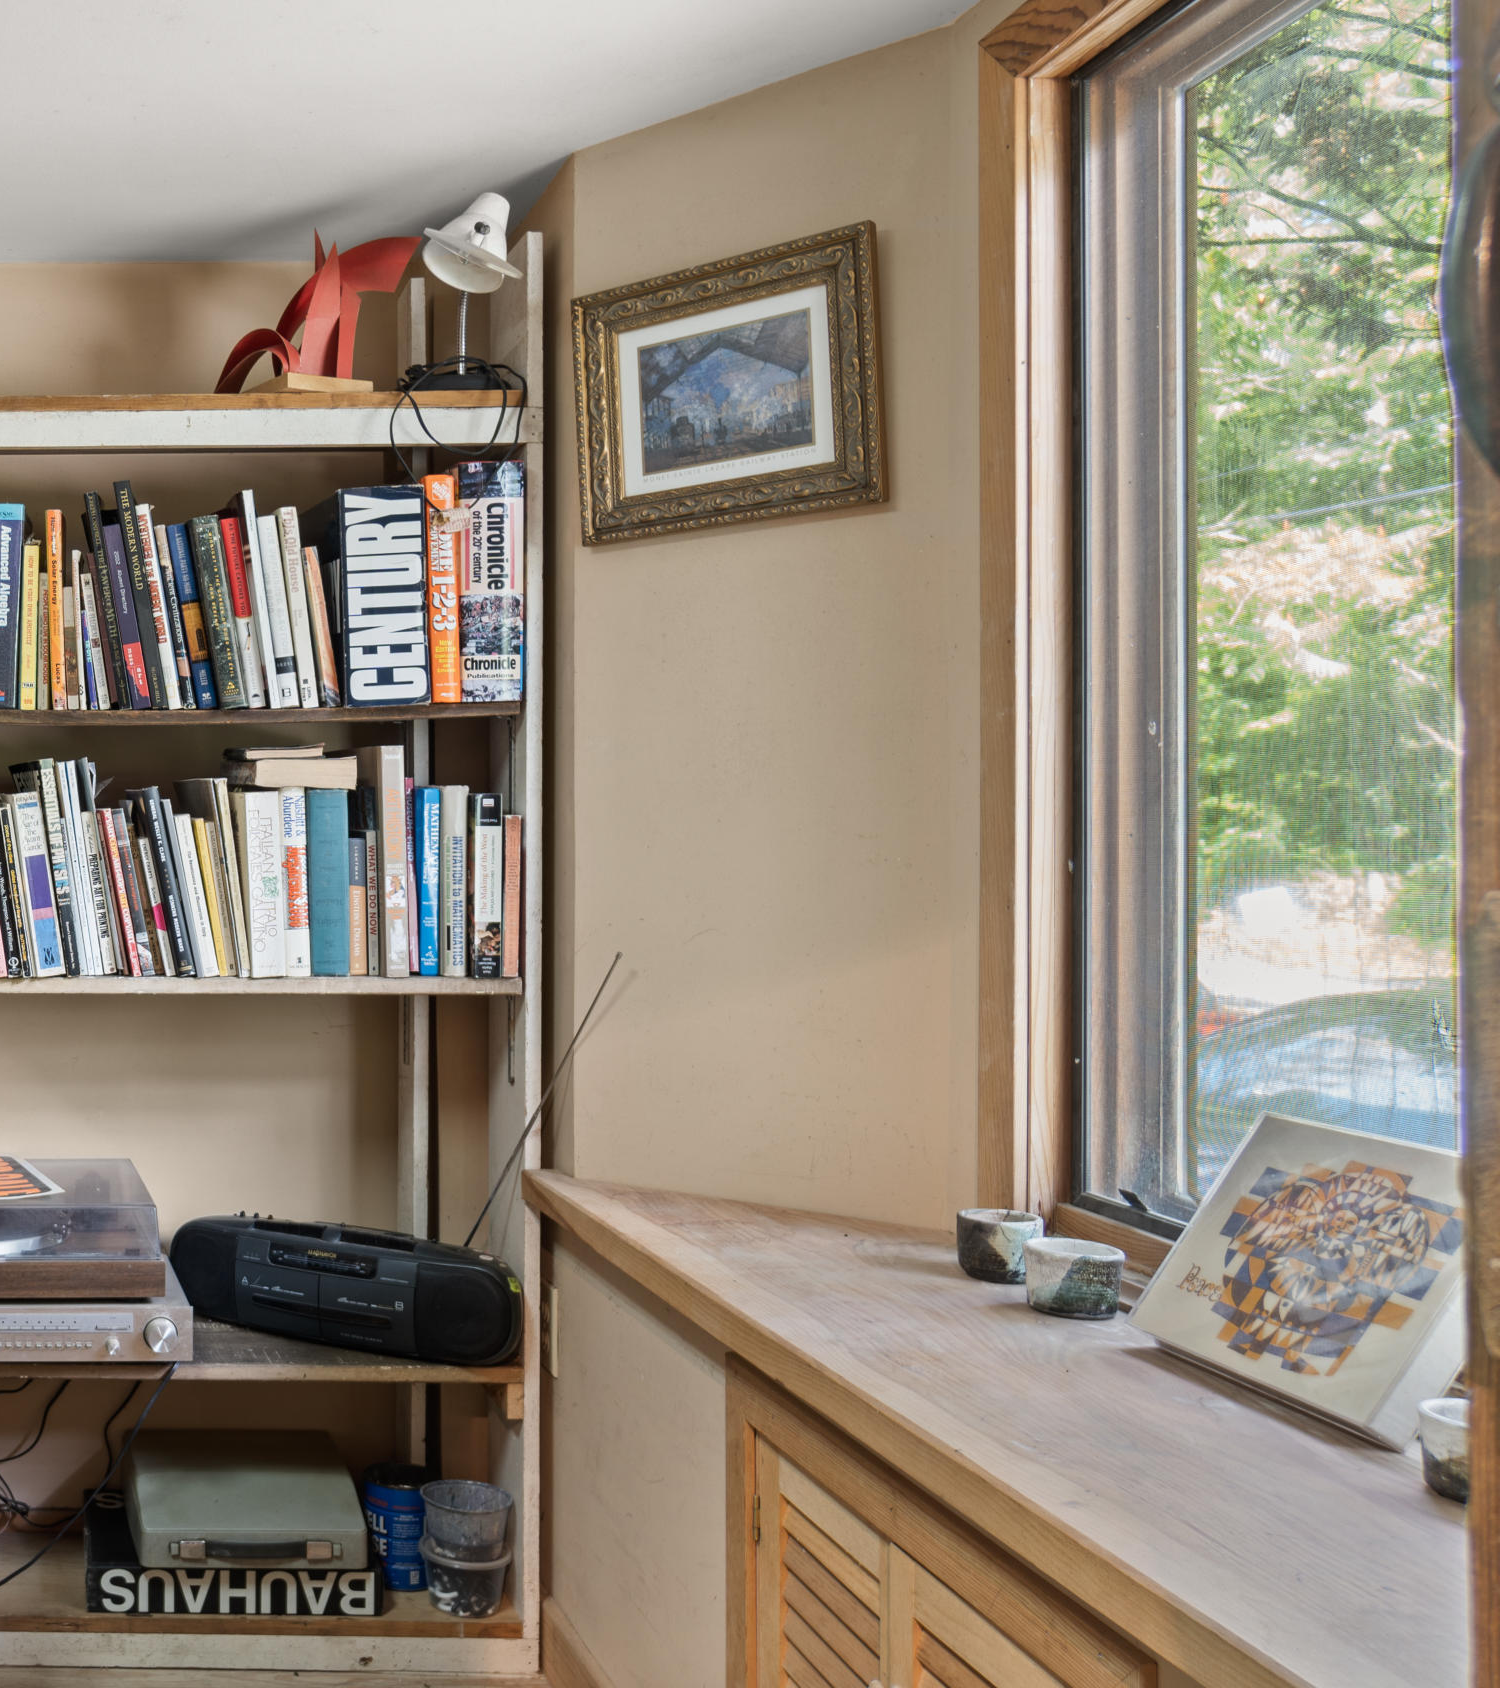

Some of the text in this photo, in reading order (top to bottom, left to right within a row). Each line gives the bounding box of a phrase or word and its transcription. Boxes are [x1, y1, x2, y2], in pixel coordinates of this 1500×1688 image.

[0, 525, 12, 581] Advanced
[118, 488, 143, 591] THE MODERN WORLD
[173, 536, 184, 559] NATIONAL
[229, 546, 239, 570] FUTURE
[281, 509, 300, 593] This Old House
[471, 511, 482, 584] of the century
[485, 502, 508, 591] Chronicle
[25, 569, 33, 577] TO
[49, 580, 58, 605] Energy
[112, 551, 129, 614] 2002 Alumni Directory
[136, 513, 167, 644] MYSTERIES ANCIENT WORLD
[207, 532, 217, 563] MIDNIGHT
[215, 589, 225, 615] GARDEN
[207, 584, 215, 599] JOHN
[234, 572, 243, 599] CATCHES
[169, 597, 183, 644] Civilizations
[238, 601, 246, 616] YOU
[344, 494, 428, 701] CENTURY
[430, 575, 456, 632] 1-2-3
[103, 608, 117, 638] MYTH
[463, 656, 516, 671] Chronicle
[40, 768, 69, 895] ESSENTIALS OF PHYSICS
[148, 799, 157, 820] GENERAL
[151, 821, 160, 840] WESLEY
[281, 794, 293, 838] Aburdene
[292, 795, 305, 828] Naisbitt
[384, 788, 402, 859] ART HISTORY
[259, 817, 276, 873] ITALIAN
[429, 803, 440, 884] MATHEMATICS
[478, 852, 487, 864] the
[479, 834, 487, 849] West
[88, 853, 109, 939] PREPARING ART FOR PRINTING
[281, 846, 308, 928] Megatrends 2000
[367, 844, 376, 936] WHAT WE DO NOW
[451, 836, 463, 967] INVITATION to MATHEMATICS
[478, 873, 489, 901] Making
[5, 930, 14, 951] Williams
[168, 895, 184, 952] WINNING MODERN WARS
[251, 886, 266, 952] CALVINO
[262, 900, 277, 937] ITALO
[353, 927, 361, 956] DREAMS
[99, 1568, 376, 1615] BAUHAUS
